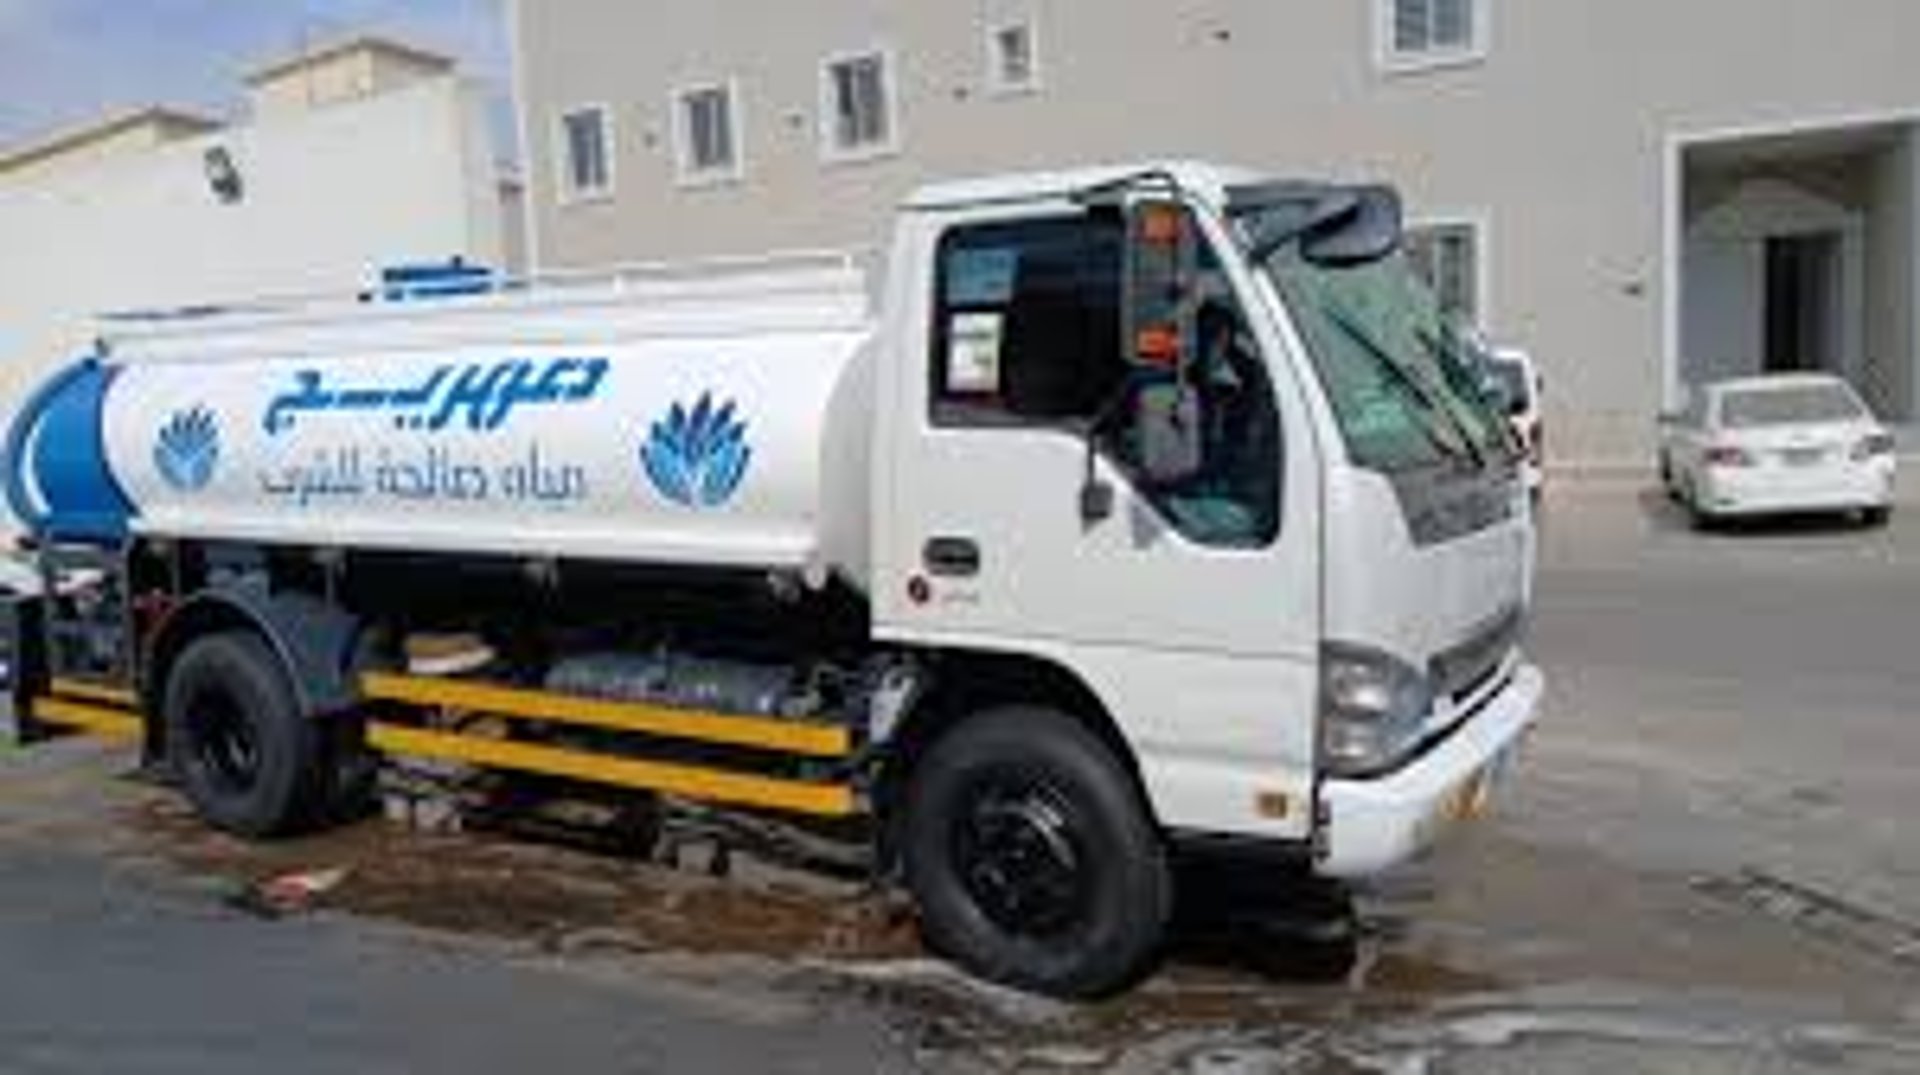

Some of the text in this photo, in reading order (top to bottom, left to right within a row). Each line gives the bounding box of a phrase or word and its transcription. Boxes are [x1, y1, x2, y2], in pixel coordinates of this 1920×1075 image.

[257, 439, 587, 510] مياه صالحة للشرب
